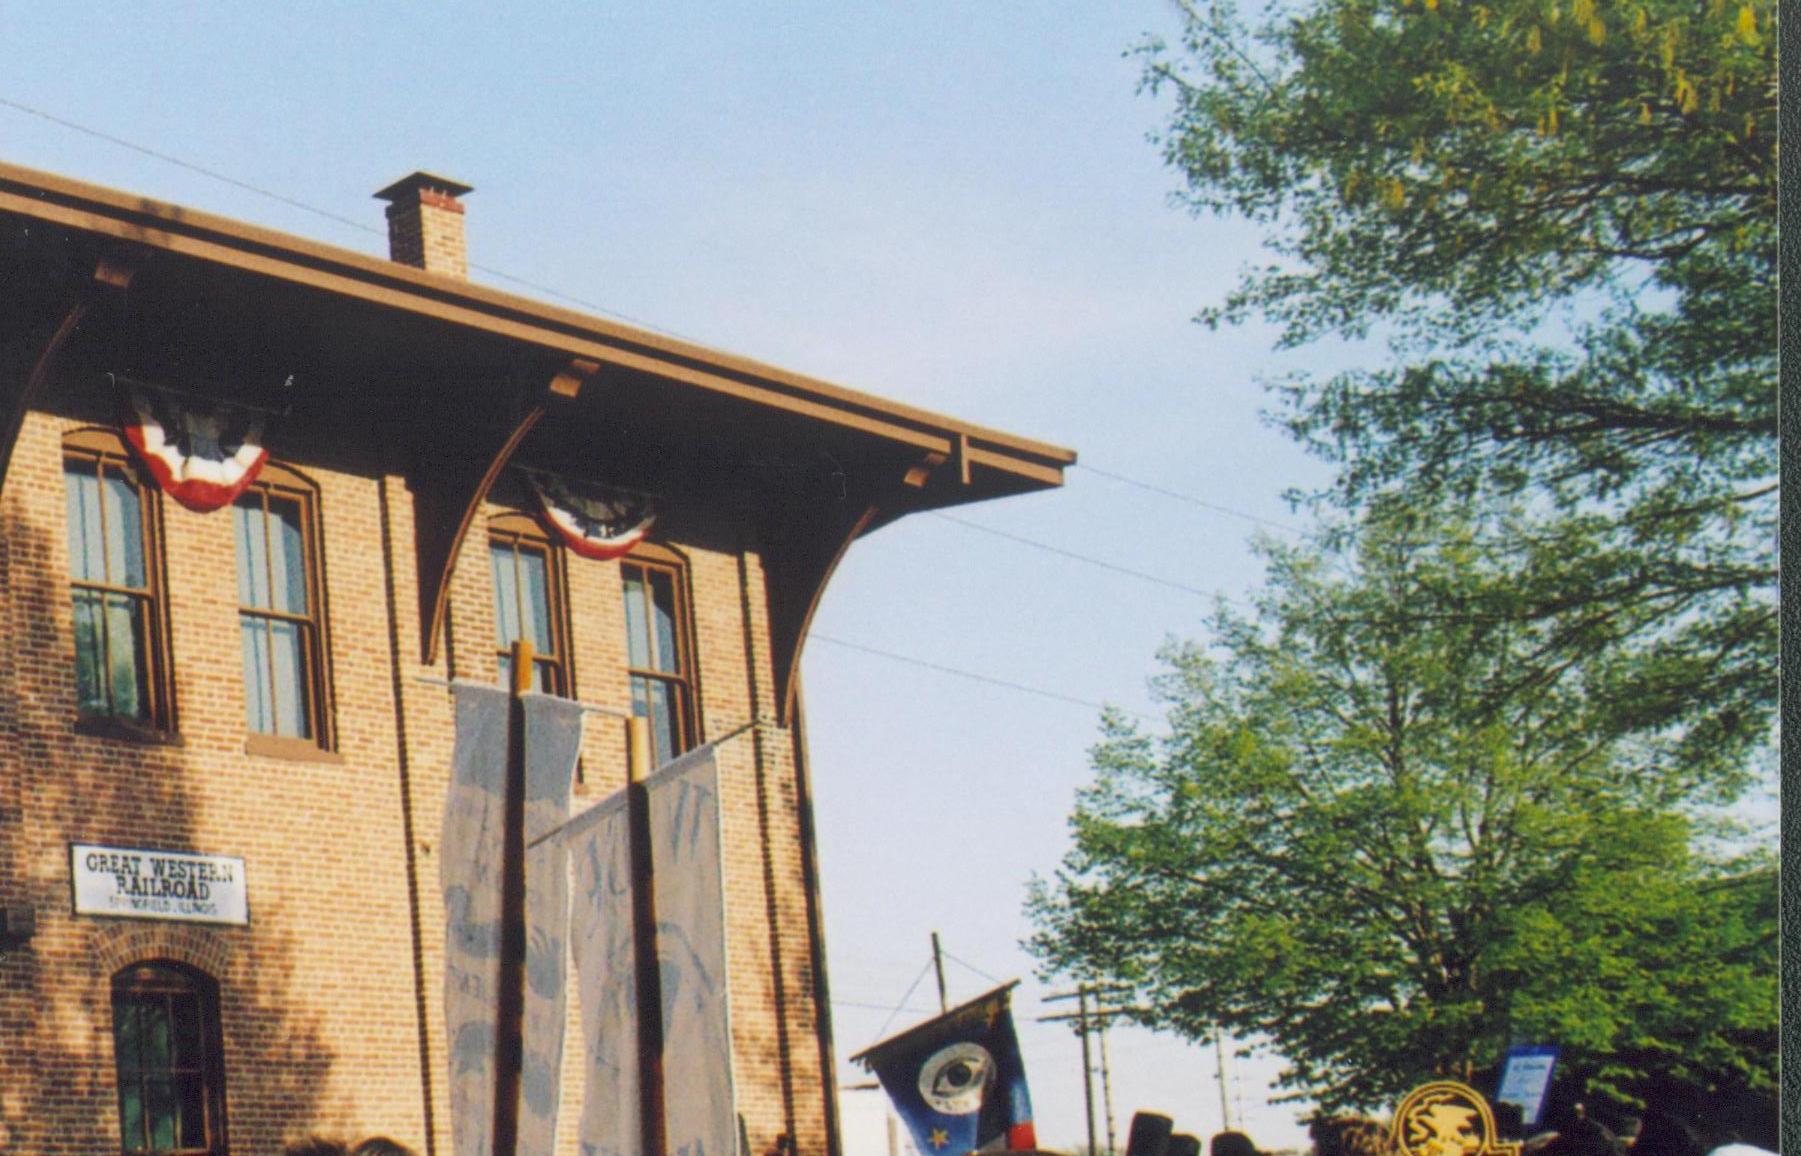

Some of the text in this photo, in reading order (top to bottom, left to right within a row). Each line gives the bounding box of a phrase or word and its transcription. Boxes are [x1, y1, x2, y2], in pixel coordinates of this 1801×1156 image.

[85, 853, 234, 883] GREAT WESTERN
[116, 875, 211, 901] RAILROAD
